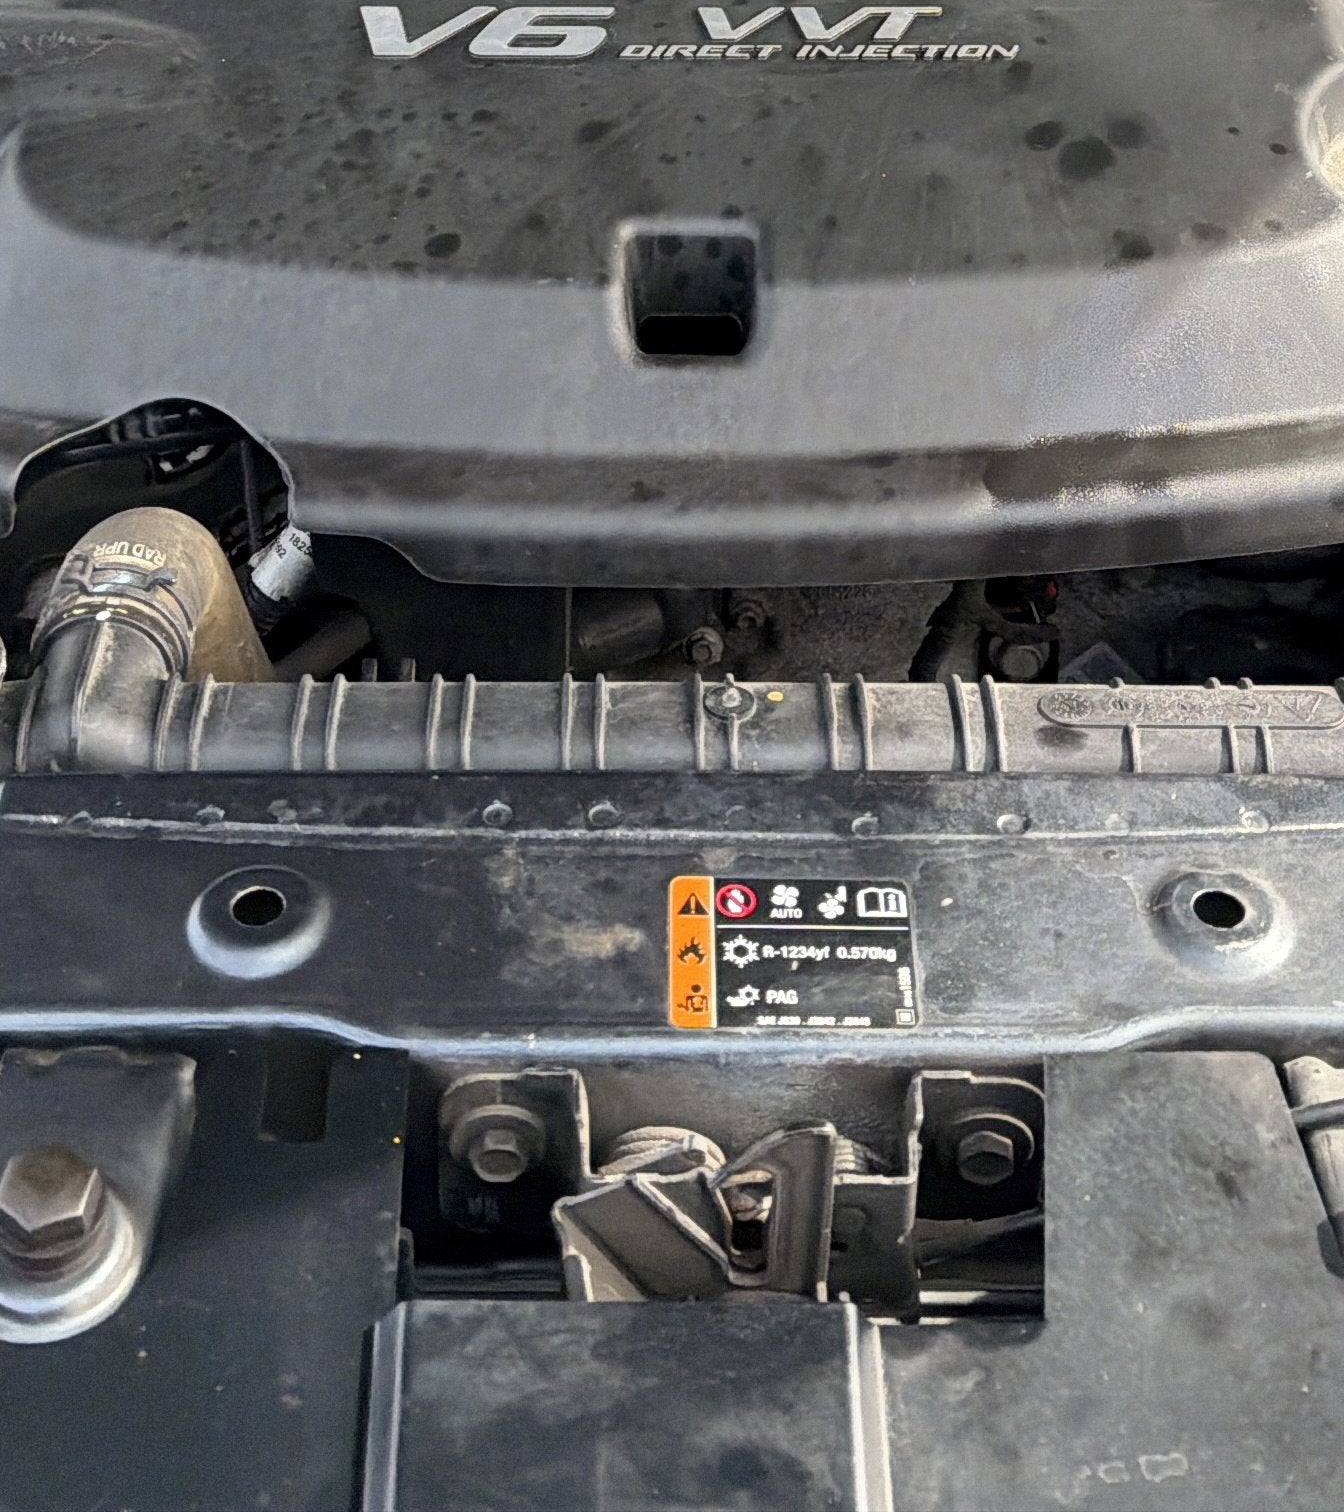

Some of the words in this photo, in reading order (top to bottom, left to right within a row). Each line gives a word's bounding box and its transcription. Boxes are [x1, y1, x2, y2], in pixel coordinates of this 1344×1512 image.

[360, 5, 617, 61] V6
[697, 5, 944, 43] VVT
[617, 43, 783, 62] DIRECT
[796, 43, 1020, 62] INJECTION
[93, 541, 130, 558] UPR
[131, 543, 167, 567] RAD
[769, 908, 803, 919] AUTO
[762, 944, 831, 961] R-1234yf
[836, 945, 898, 962] 0.570kg
[765, 989, 799, 1005] PAG
